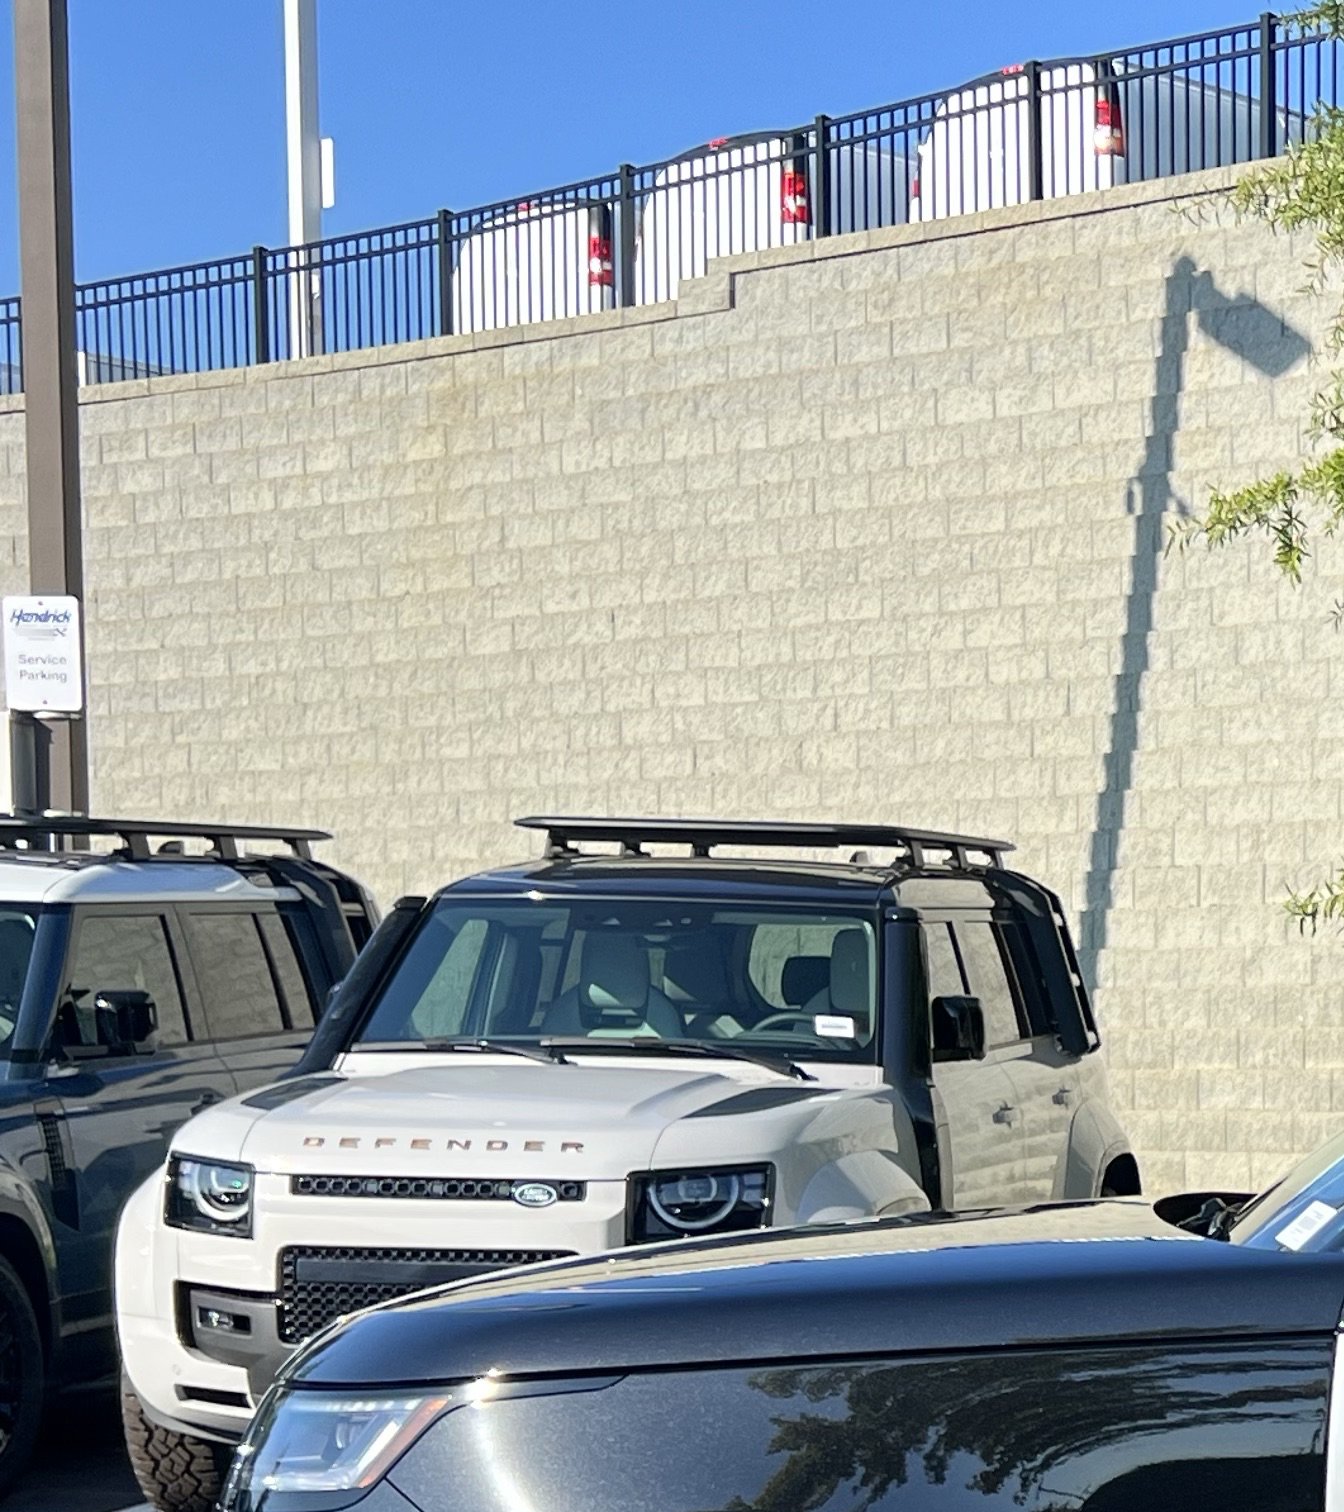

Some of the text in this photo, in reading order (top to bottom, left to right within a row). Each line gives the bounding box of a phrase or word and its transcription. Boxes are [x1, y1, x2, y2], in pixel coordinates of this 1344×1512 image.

[10, 608, 71, 627] Hendrick
[18, 654, 67, 665] Service
[19, 669, 68, 683] Parking
[303, 1137, 584, 1153] DEFENDER
